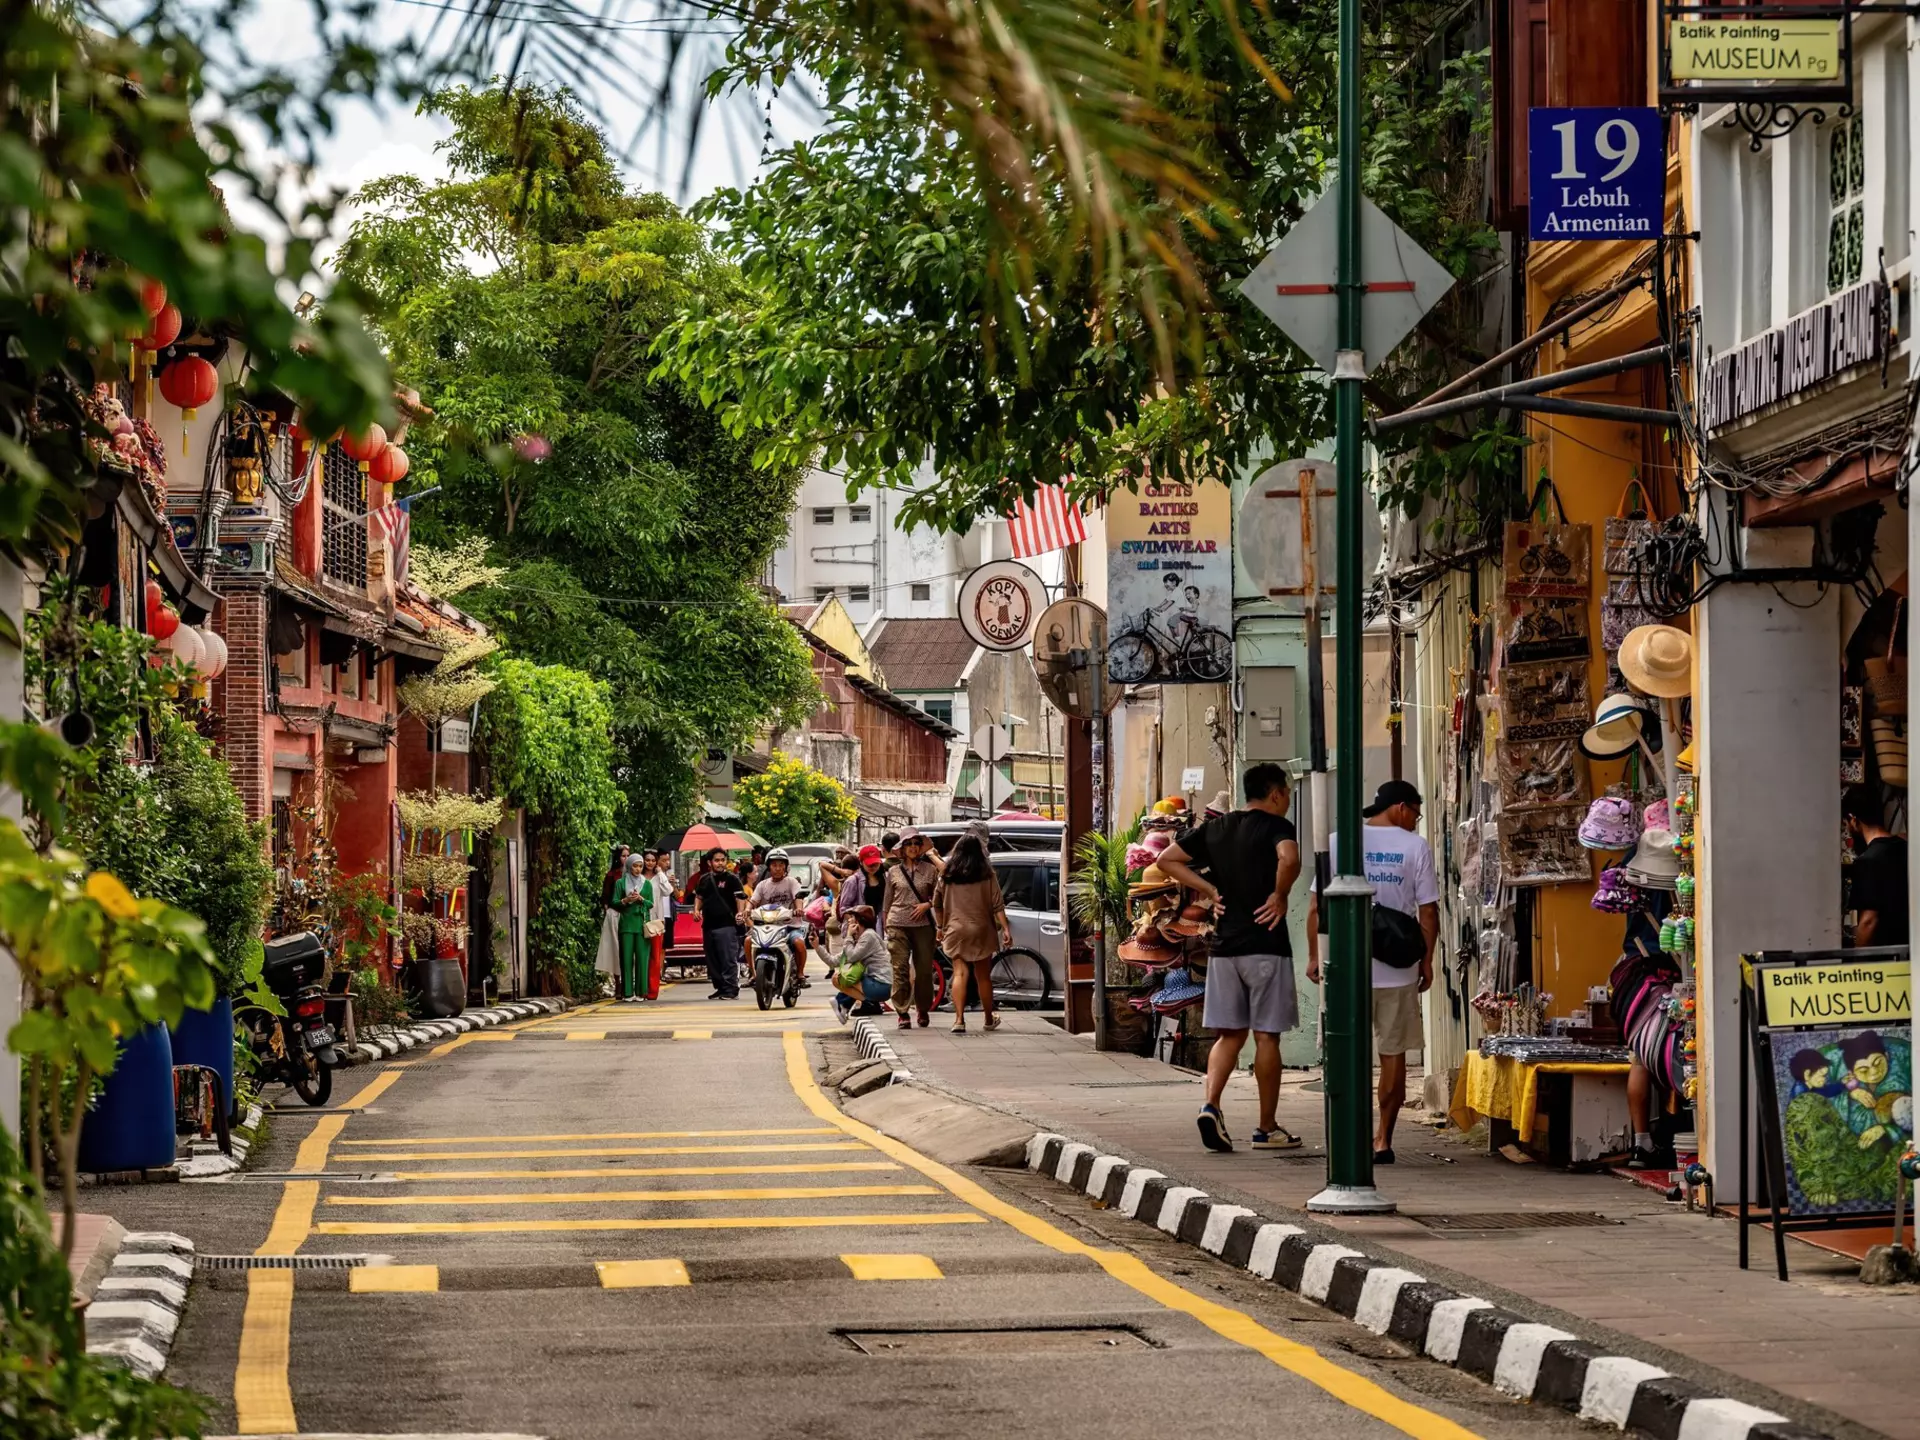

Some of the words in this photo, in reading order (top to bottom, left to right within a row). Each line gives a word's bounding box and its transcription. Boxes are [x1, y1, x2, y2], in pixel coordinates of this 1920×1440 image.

[1679, 26, 1716, 39] Batik
[1720, 26, 1780, 41] Painting
[1692, 48, 1801, 70] MUSEUM
[1807, 57, 1828, 72] Pg
[1551, 119, 1640, 182] 19
[1561, 187, 1631, 208] Lebuh
[1542, 212, 1651, 233] Armenian
[1703, 354, 1733, 432] BATIK
[1782, 306, 1826, 397] MUSEUM
[1829, 282, 1876, 375] PENANG
[1145, 483, 1194, 498] GIFTS
[1139, 502, 1199, 517] BATIKS
[1148, 521, 1191, 535] ARTS
[1121, 540, 1218, 554] SWIMWEAR
[1137, 559, 1160, 570] and
[986, 581, 1017, 597] KOPI
[985, 614, 1023, 638] LOEWAK
[1368, 872, 1404, 886] holiday
[1772, 972, 1813, 987] Batik
[1817, 969, 1884, 984] Painting
[1790, 990, 1911, 1018] MUSEUM
